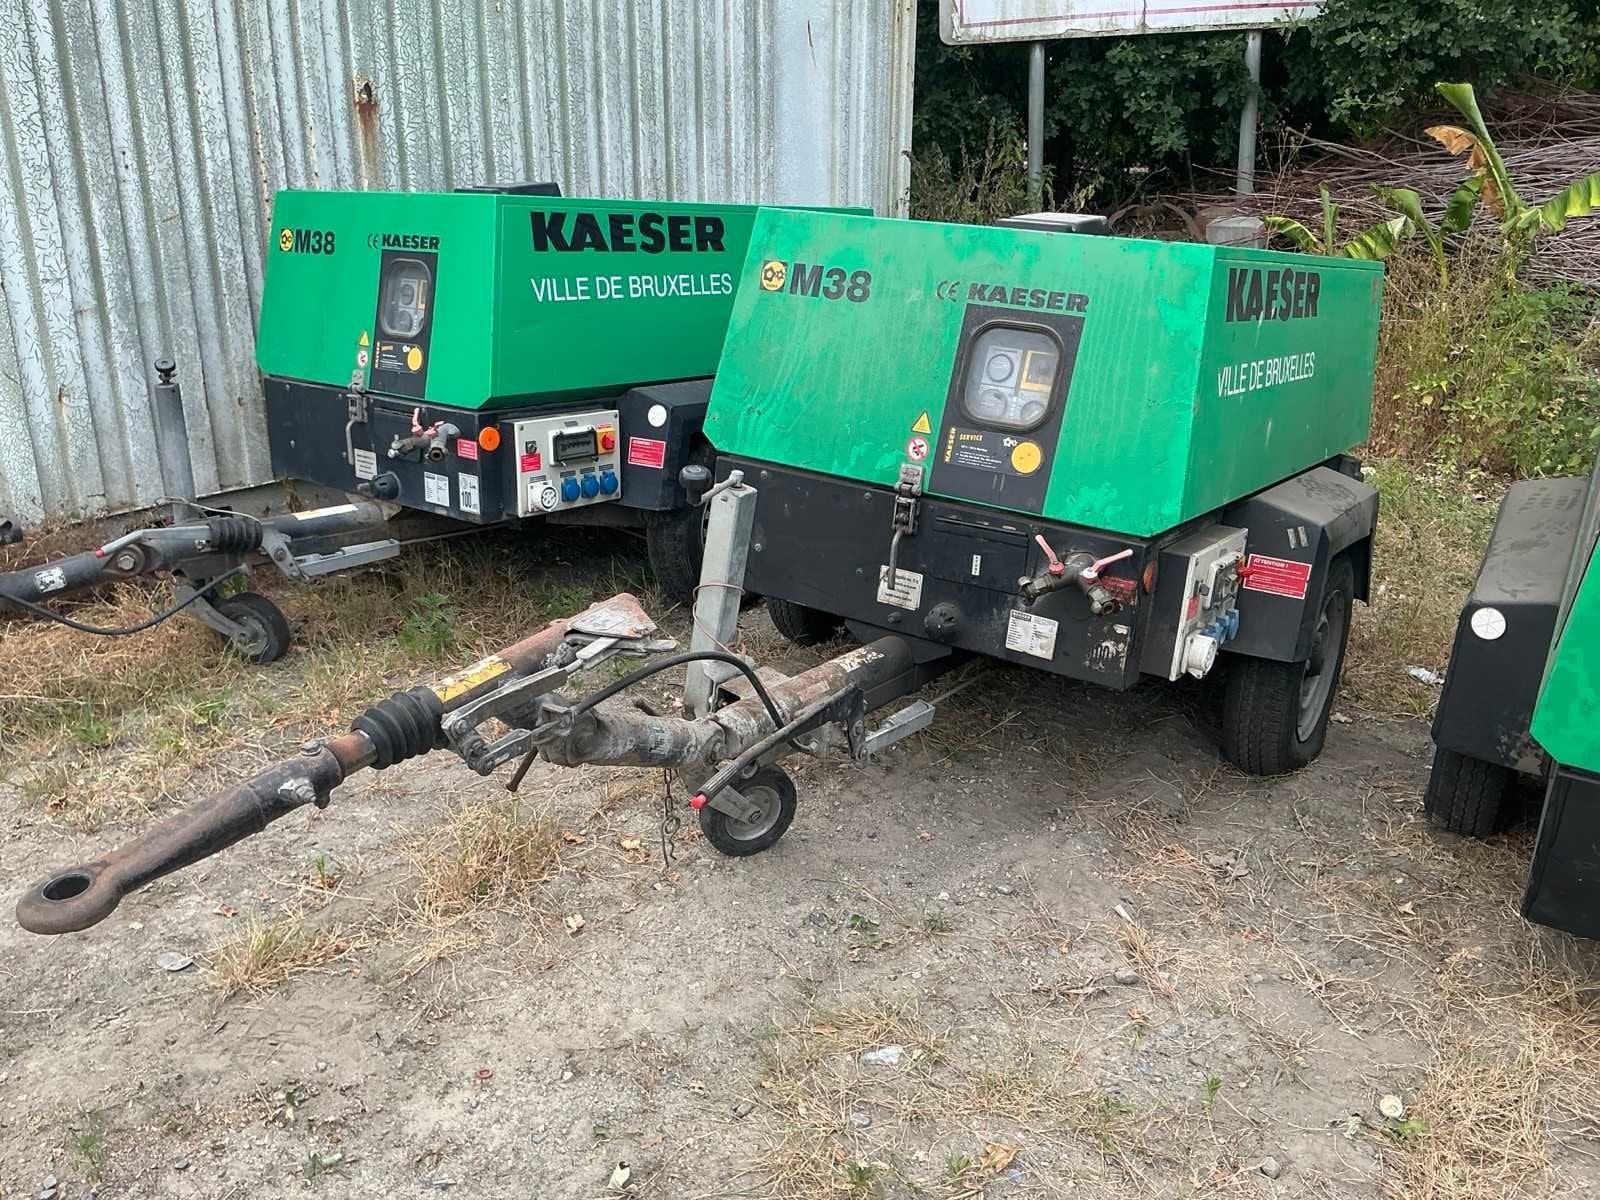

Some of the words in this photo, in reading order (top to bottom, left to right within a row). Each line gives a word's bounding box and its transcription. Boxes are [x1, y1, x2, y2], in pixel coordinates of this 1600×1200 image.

[295, 229, 335, 255] M38
[382, 234, 440, 249] KAESER
[530, 211, 726, 254] KAESER
[531, 277, 591, 302] VILLE
[596, 276, 624, 299] DE
[629, 273, 733, 298] BRUXELLES
[789, 263, 872, 303] M38
[967, 283, 1089, 312] KAESER
[1225, 268, 1321, 322] KAESER
[1218, 363, 1248, 396] VILLE
[1249, 360, 1264, 391] DE
[1265, 352, 1315, 387] BRUXELLES
[944, 427, 957, 463] KAESER
[959, 433, 983, 442] SERVICE
[1253, 558, 1285, 568] ATTENTION
